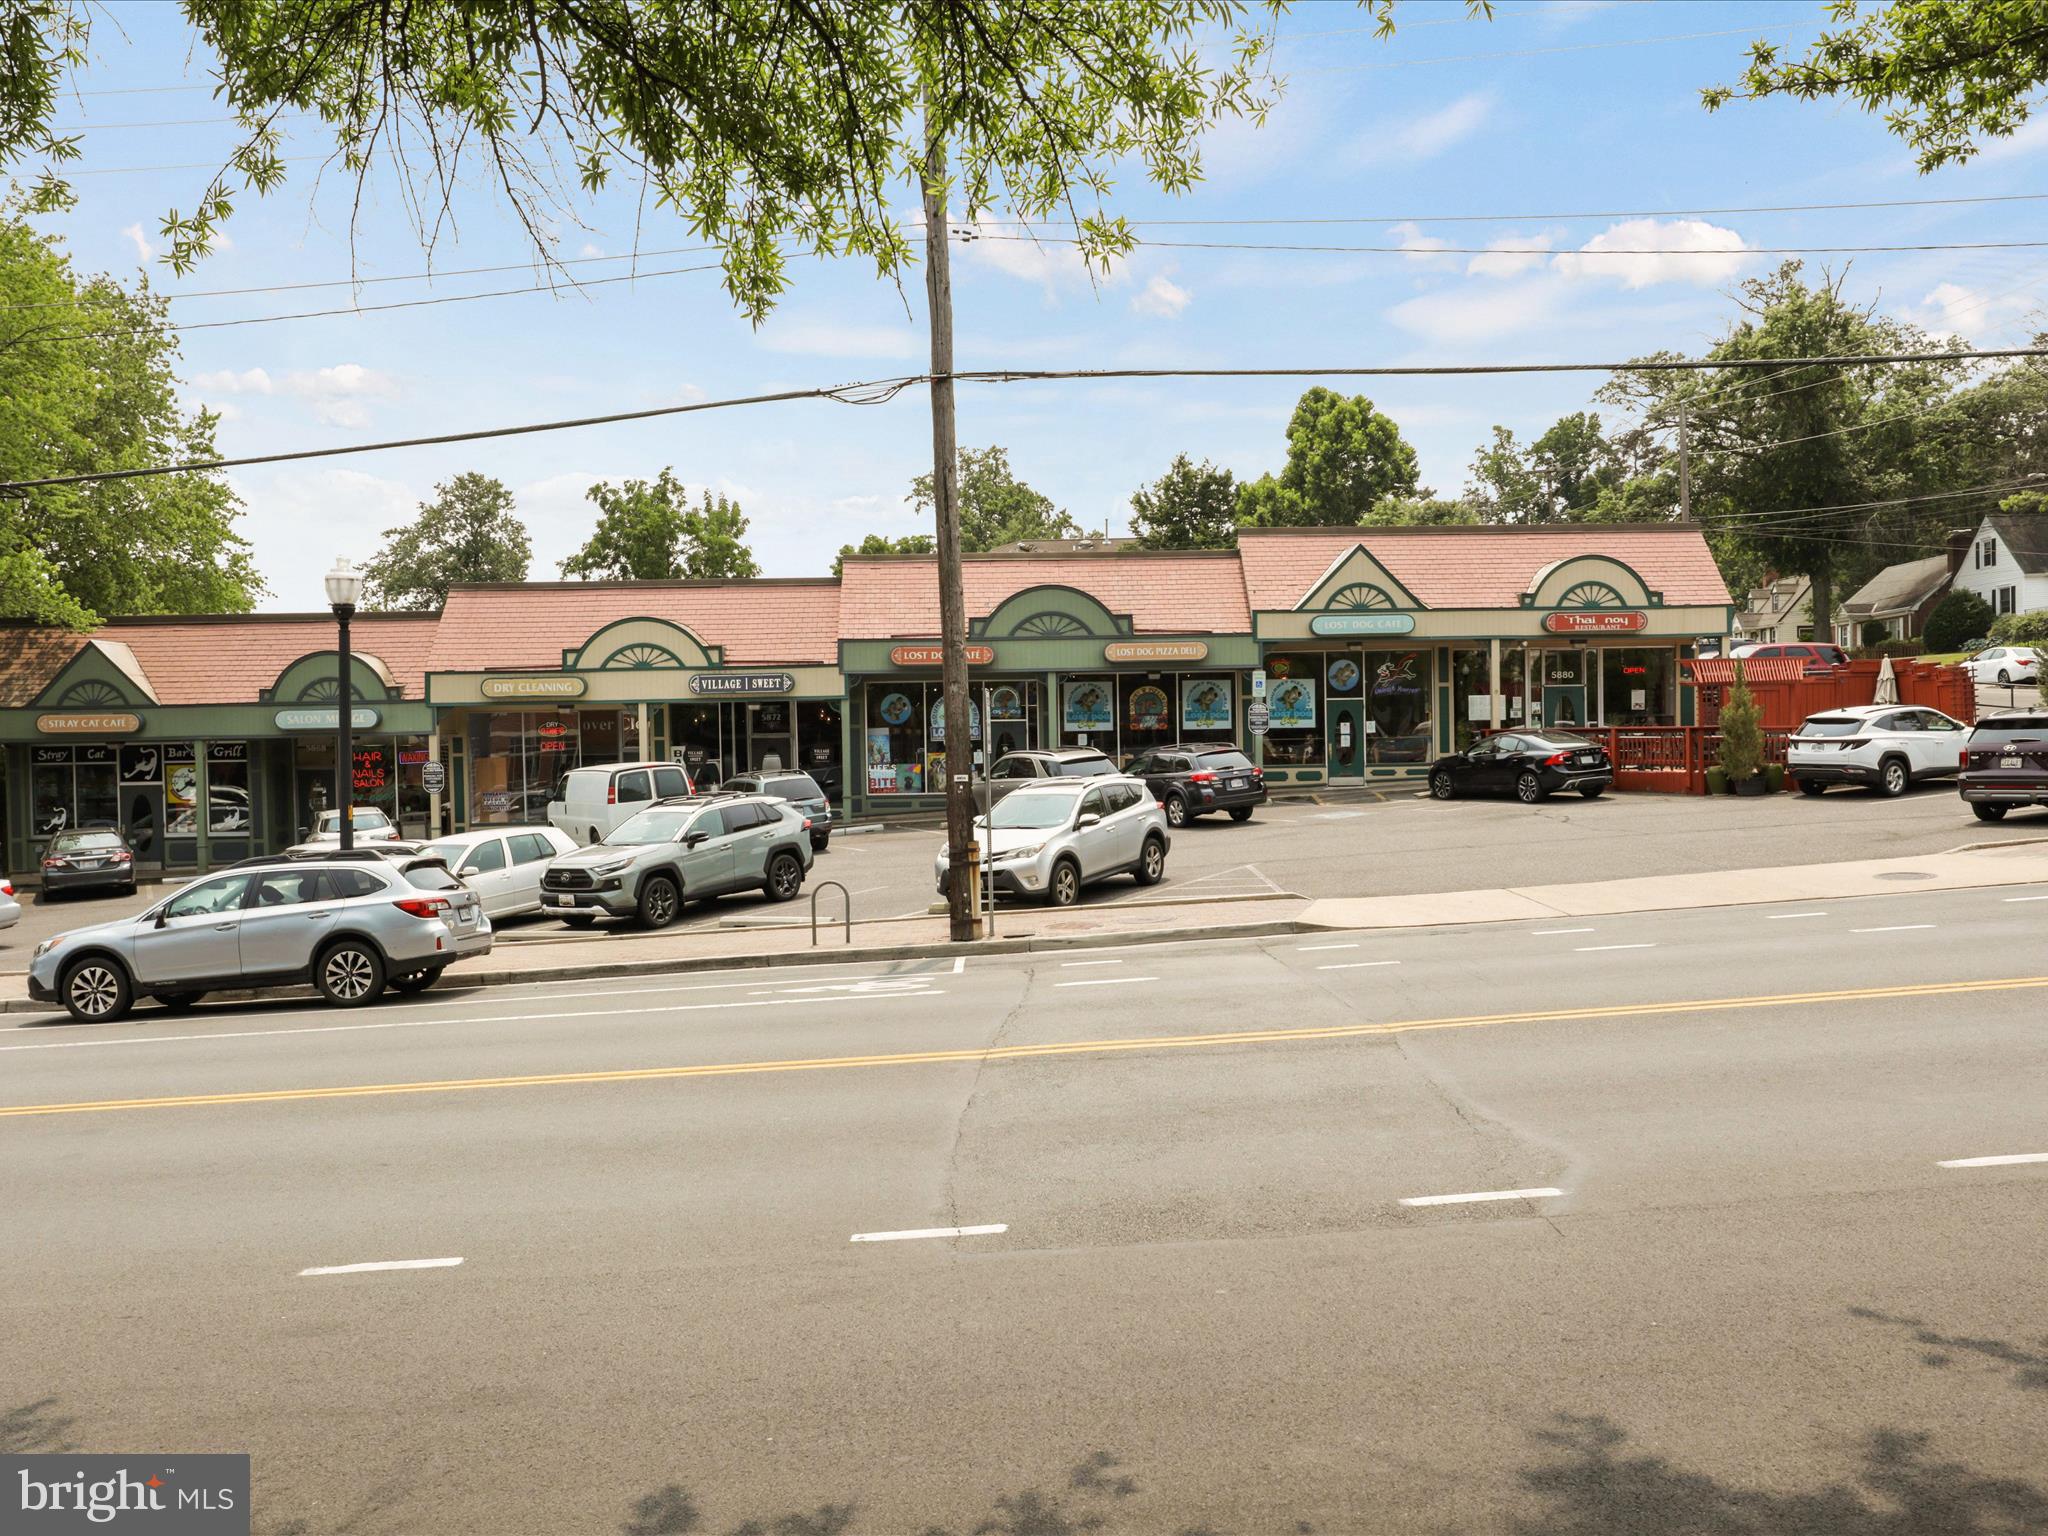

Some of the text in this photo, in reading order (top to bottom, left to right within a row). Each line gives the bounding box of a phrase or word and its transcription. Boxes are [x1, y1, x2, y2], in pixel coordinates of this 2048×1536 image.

[1324, 621, 1346, 629] LOST
[1352, 620, 1375, 629] DOG
[1564, 615, 1596, 625] Thai
[904, 650, 928, 660] LOST
[931, 650, 943, 660] DO
[1116, 645, 1198, 657] LOST DOG PIZZA DELI
[1551, 670, 1574, 679] 5880
[1623, 666, 1646, 674] OPEN
[493, 681, 573, 693] DRY CLEANING
[701, 677, 781, 690] VILLAGE SWEET
[47, 719, 79, 729] STRAY
[81, 718, 100, 728] CAT
[287, 713, 319, 725] SALON
[213, 745, 243, 758] Grill
[541, 741, 566, 752] OPEN
[37, 749, 68, 762] Stray
[87, 748, 106, 760] Cat
[167, 747, 187, 758] Bar
[353, 751, 382, 761] HAIR
[364, 761, 371, 769] &
[352, 768, 385, 779] NAILS
[353, 778, 385, 788] SALON
